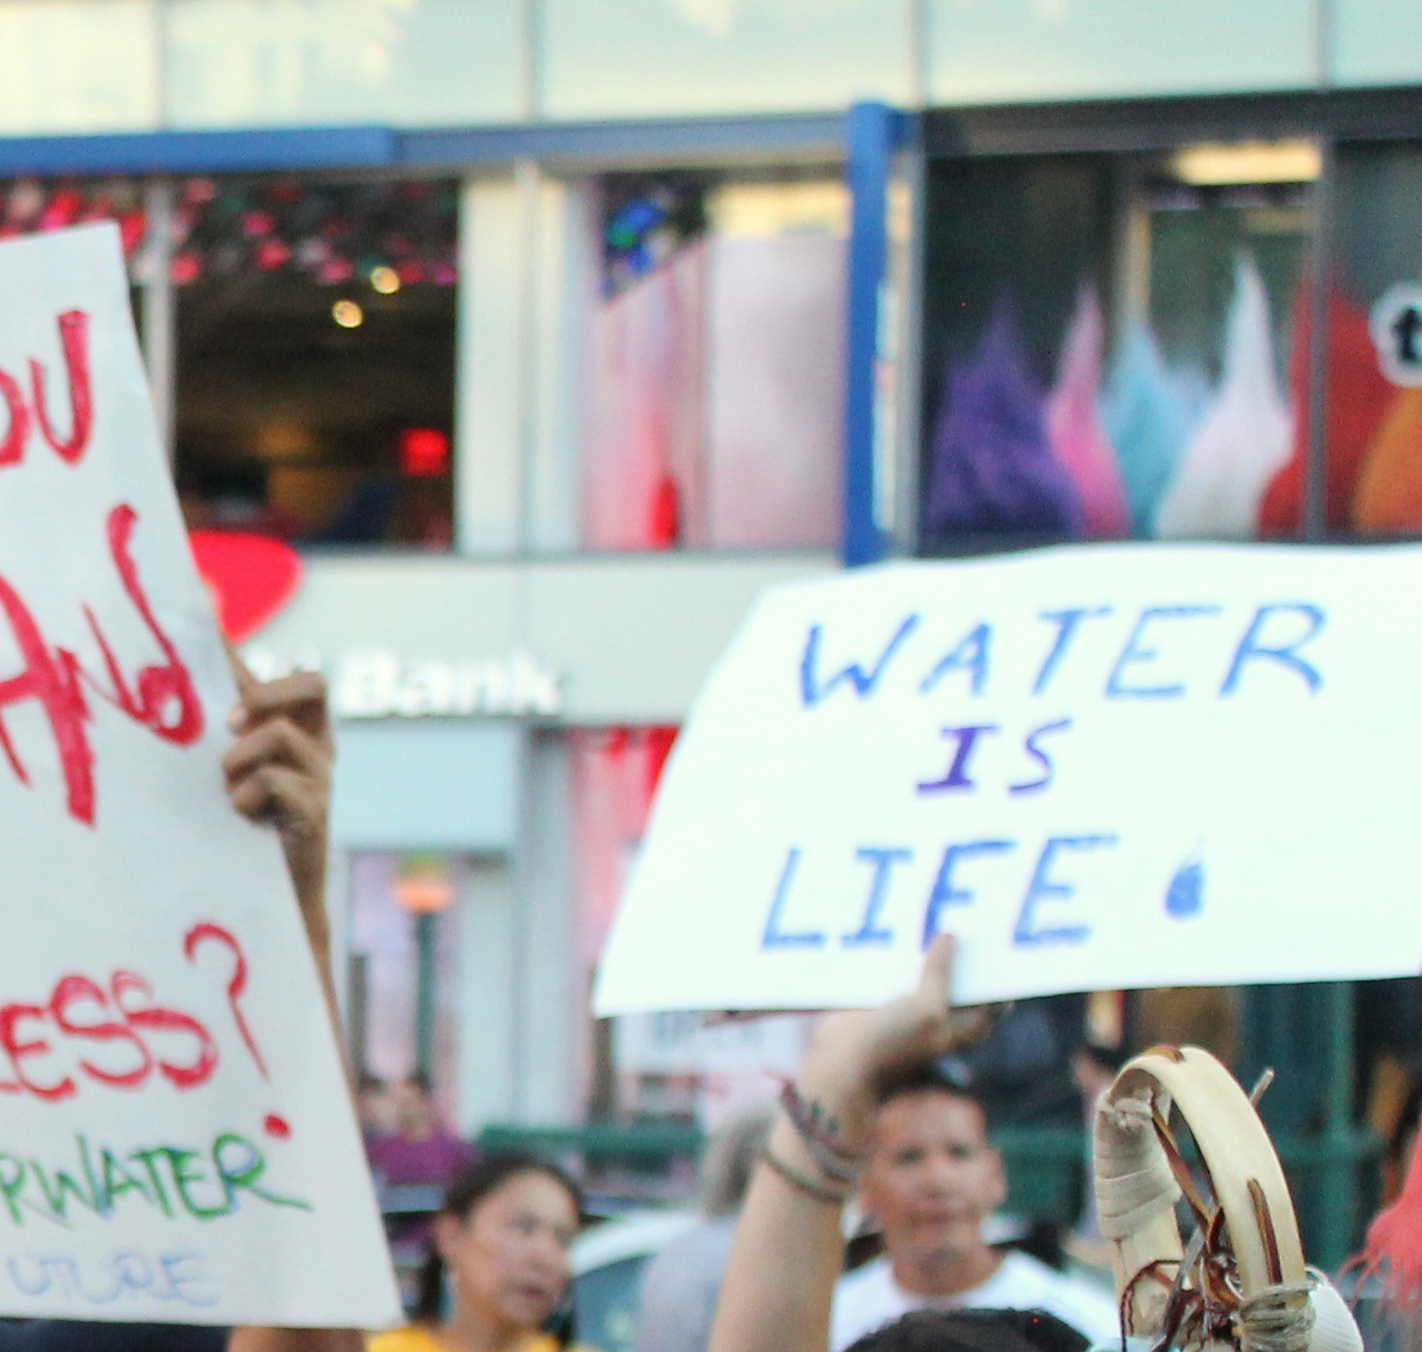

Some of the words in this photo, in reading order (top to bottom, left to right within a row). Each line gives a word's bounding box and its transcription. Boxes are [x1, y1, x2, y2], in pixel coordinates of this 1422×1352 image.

[340, 648, 558, 715] Bank
[800, 602, 1327, 709] WATER
[915, 717, 1074, 797] IS
[761, 834, 1119, 952] LIFE
